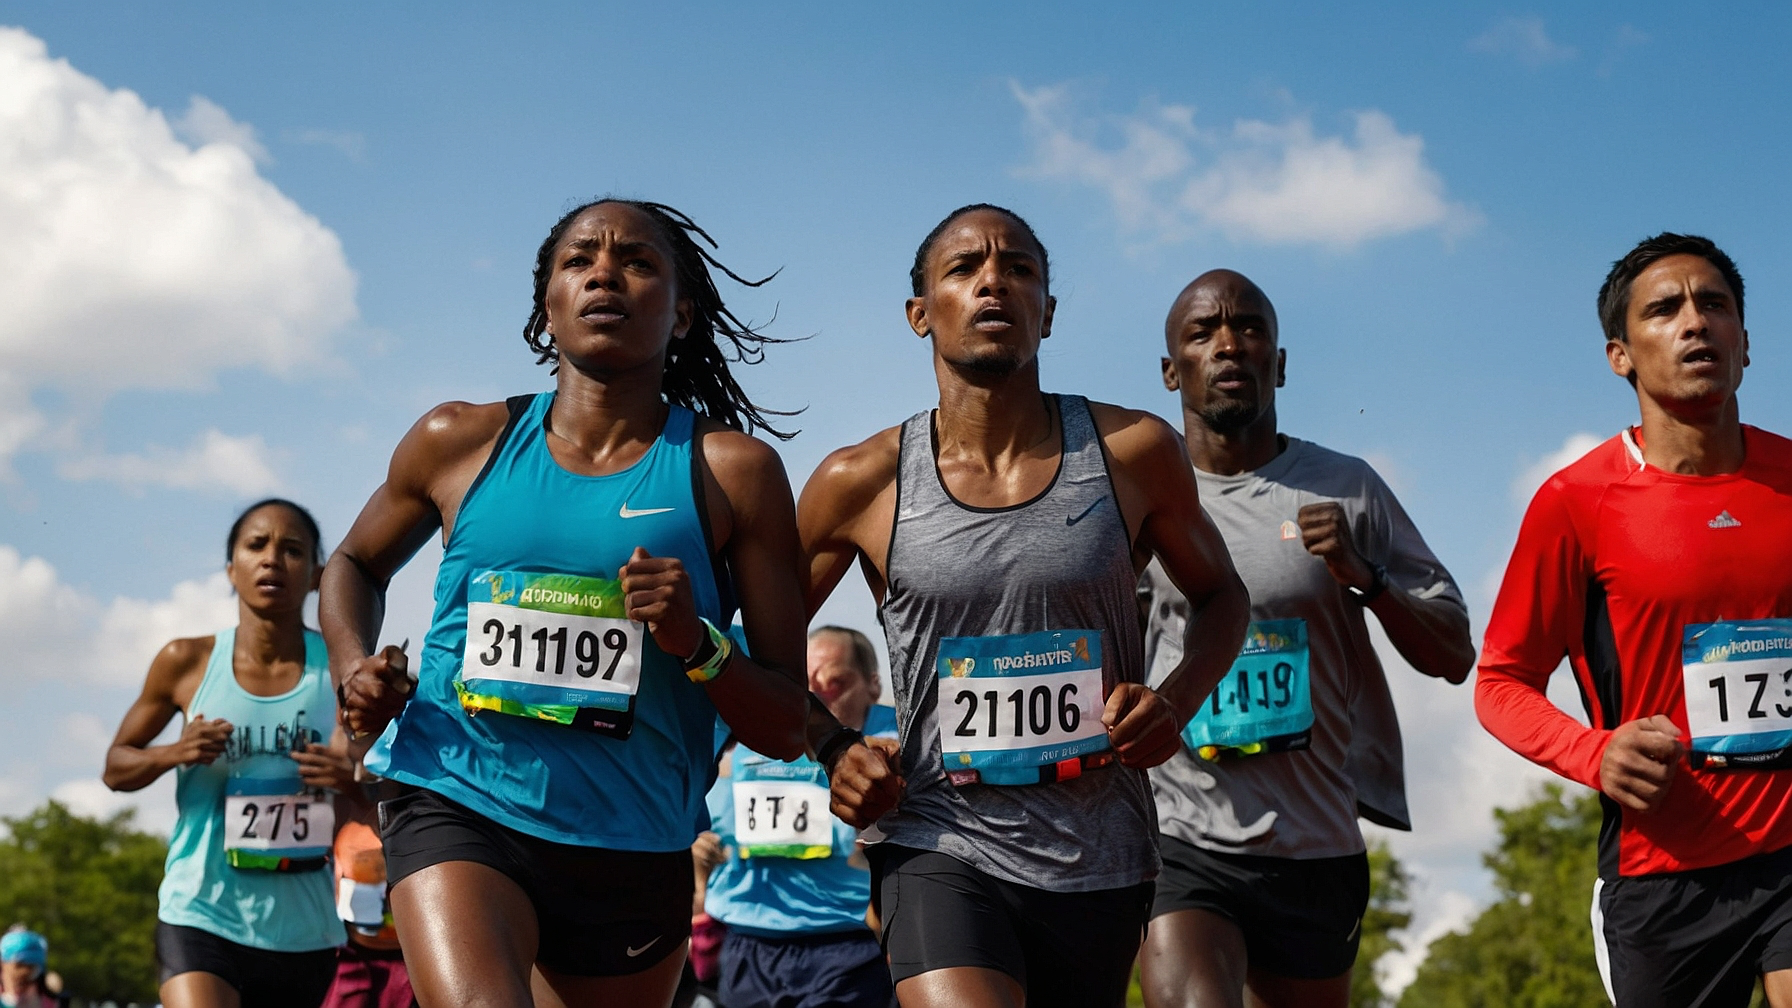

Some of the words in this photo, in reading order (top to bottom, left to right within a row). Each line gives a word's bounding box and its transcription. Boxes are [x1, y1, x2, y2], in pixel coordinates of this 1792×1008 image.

[480, 618, 628, 681] 311199
[954, 683, 1081, 737] 21106
[241, 803, 309, 842] 275
